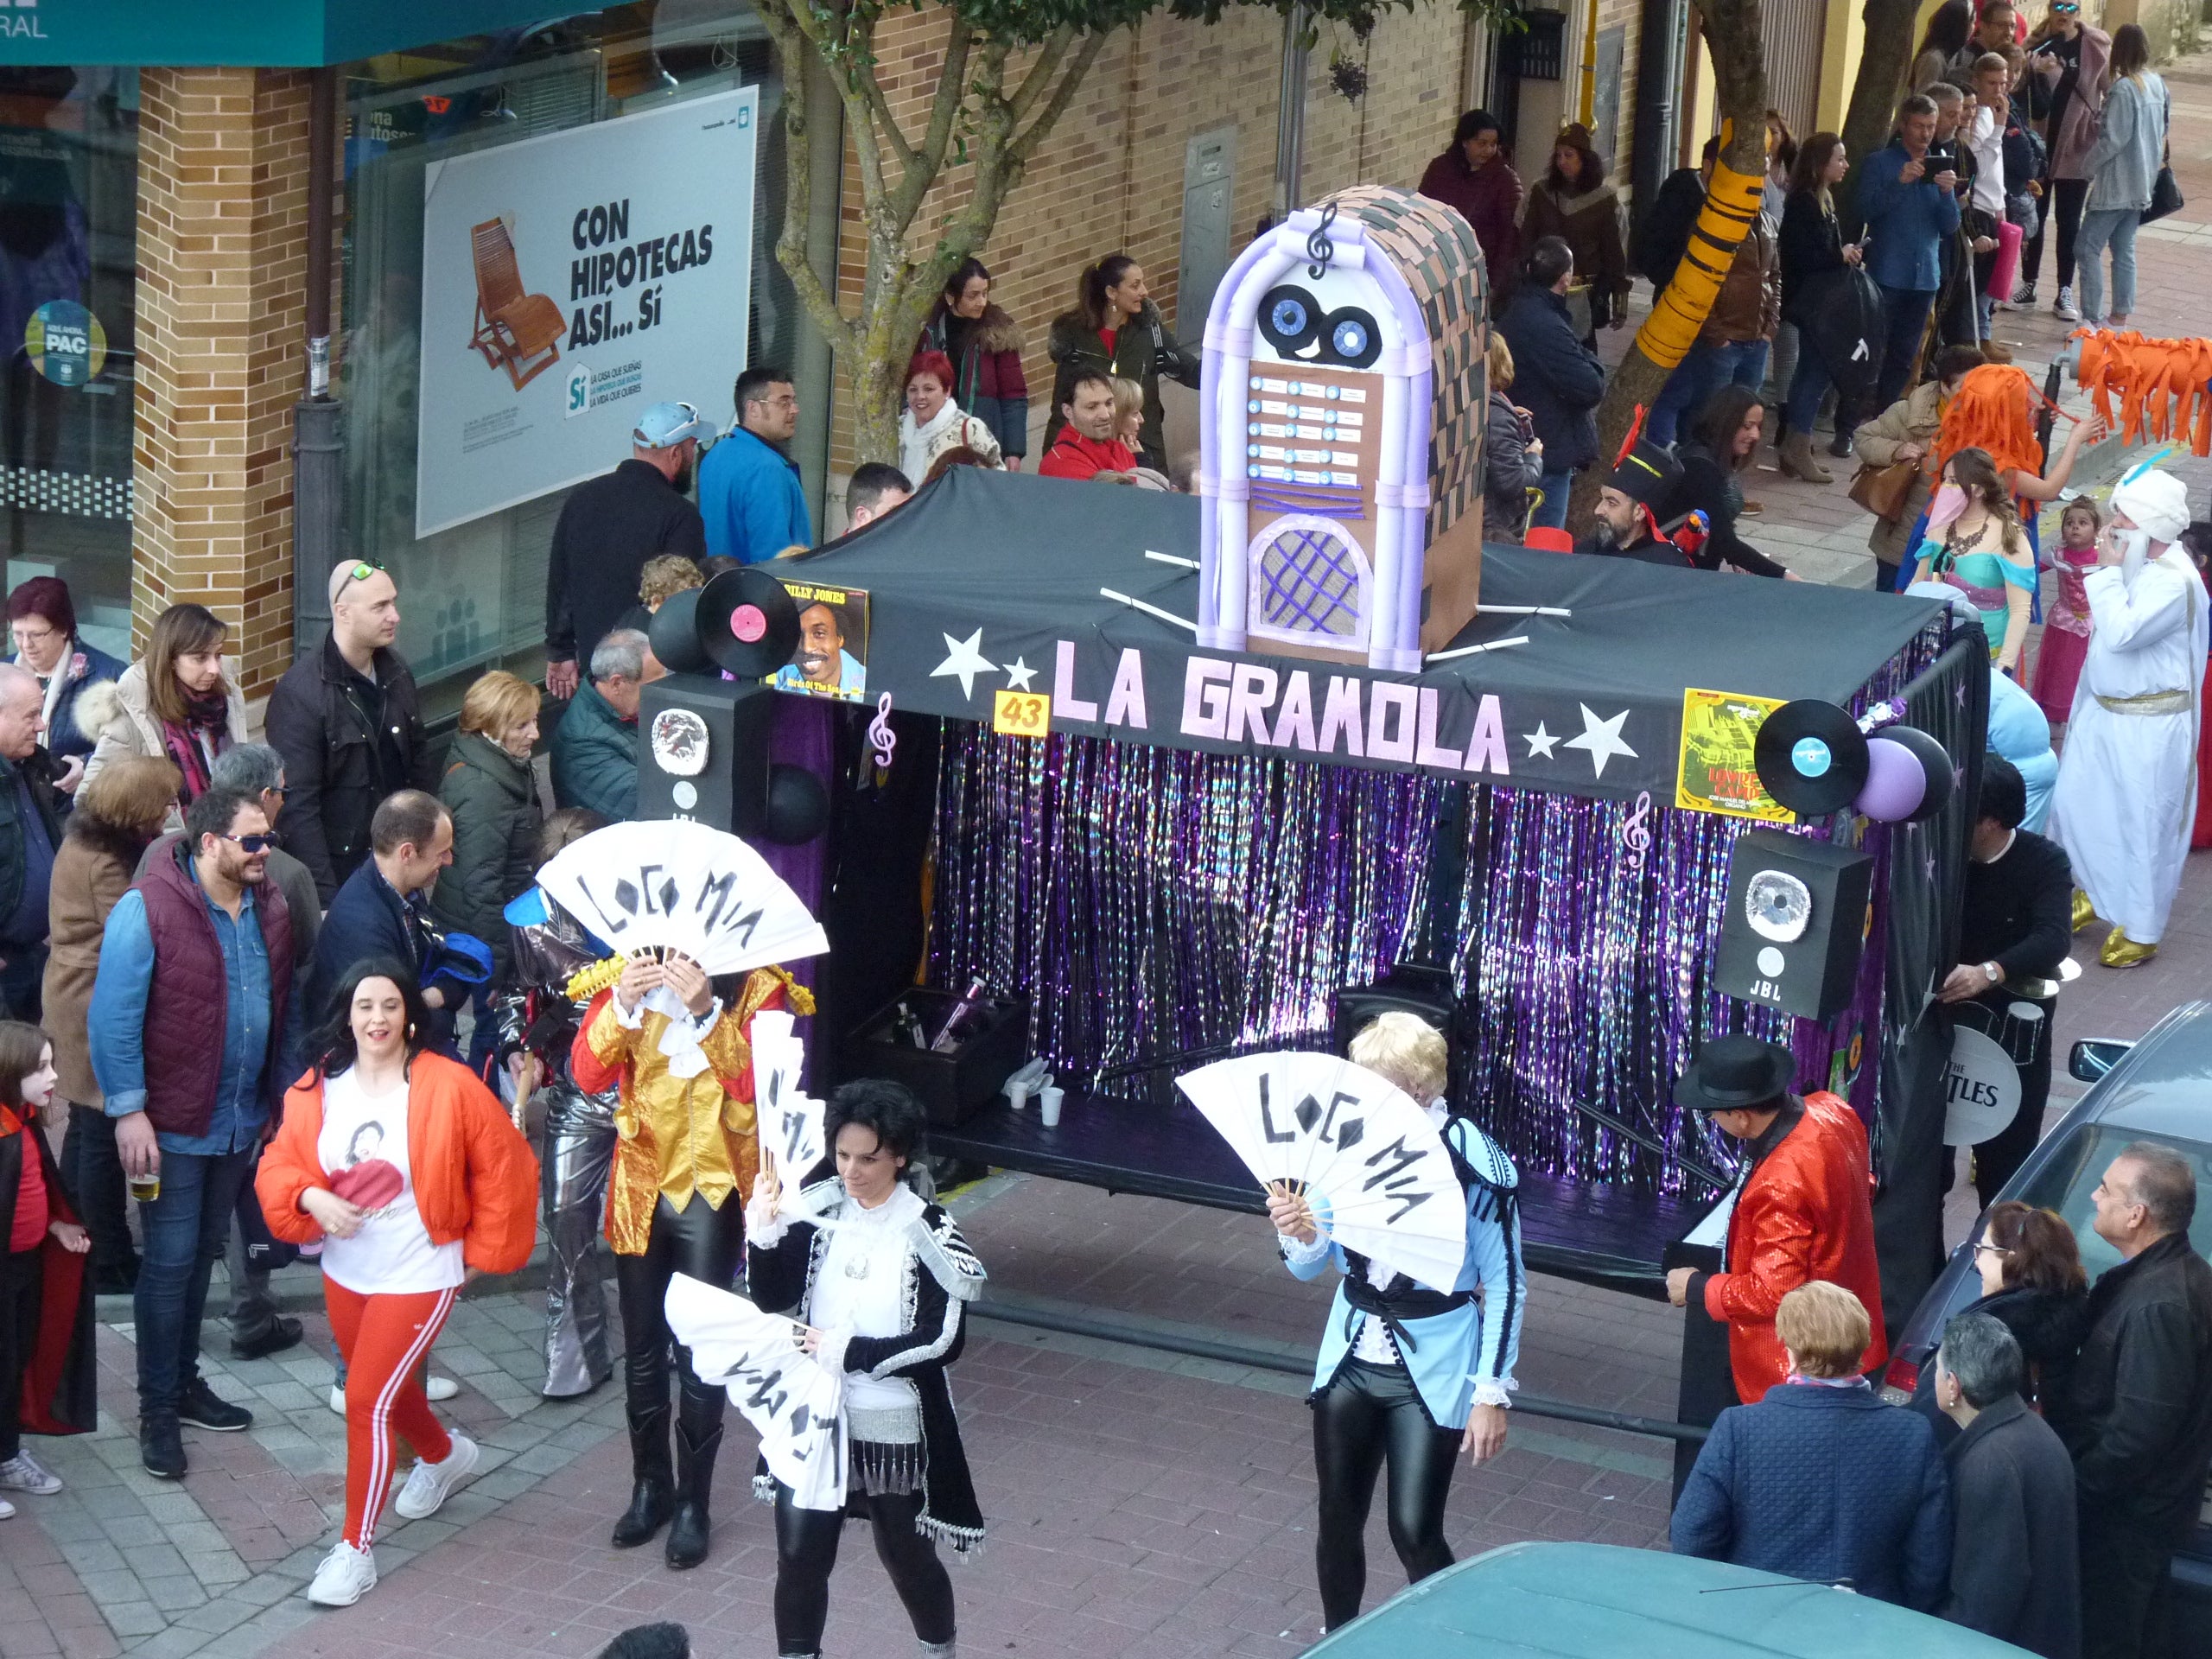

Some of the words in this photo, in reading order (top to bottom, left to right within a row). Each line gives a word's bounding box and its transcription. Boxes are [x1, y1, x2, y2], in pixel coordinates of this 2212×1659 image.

[572, 198, 629, 251] CON
[570, 224, 713, 302] HIPOTECAS
[46, 334, 86, 354] PAC
[612, 366, 622, 378] QUE
[610, 391, 620, 401] QUE
[813, 588, 846, 605] JONES
[814, 681, 826, 691] The
[1001, 696, 1042, 728] 43
[1053, 640, 1147, 728] LA
[1180, 657, 1510, 775] GRAMOLA
[1750, 979, 1781, 1001] JBL
[1949, 1061, 1967, 1074] THE
